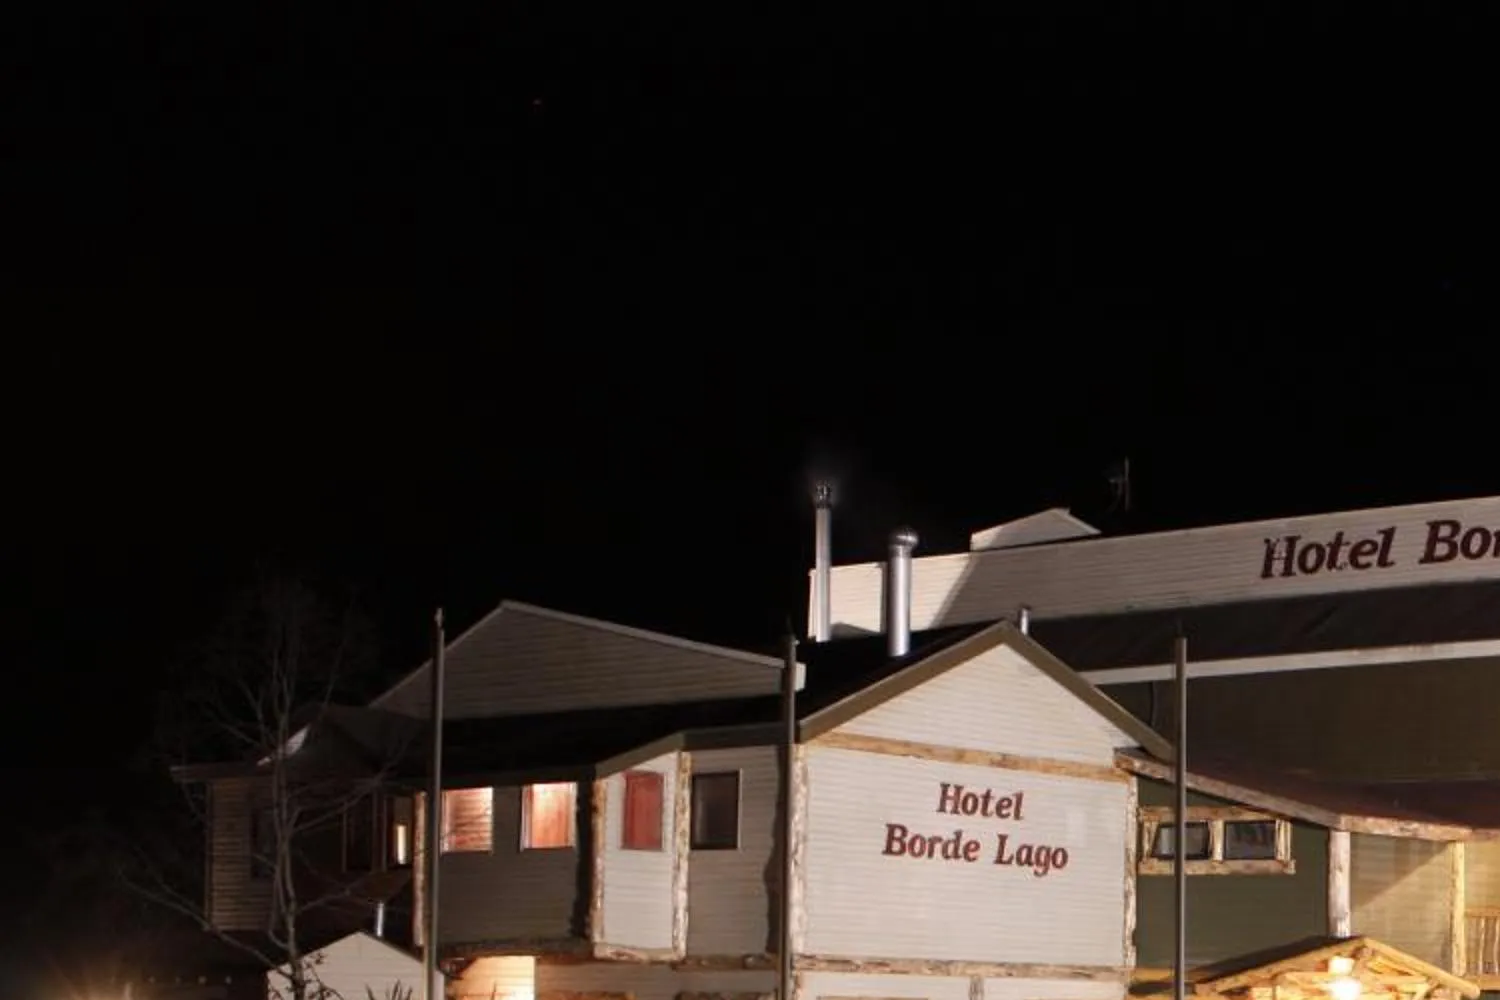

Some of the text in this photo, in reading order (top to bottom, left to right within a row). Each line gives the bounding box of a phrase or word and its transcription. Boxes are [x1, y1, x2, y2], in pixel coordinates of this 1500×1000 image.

[1259, 526, 1396, 579] Hotel
[936, 782, 1024, 821] Hotel
[882, 823, 1069, 877] Borde Lago
